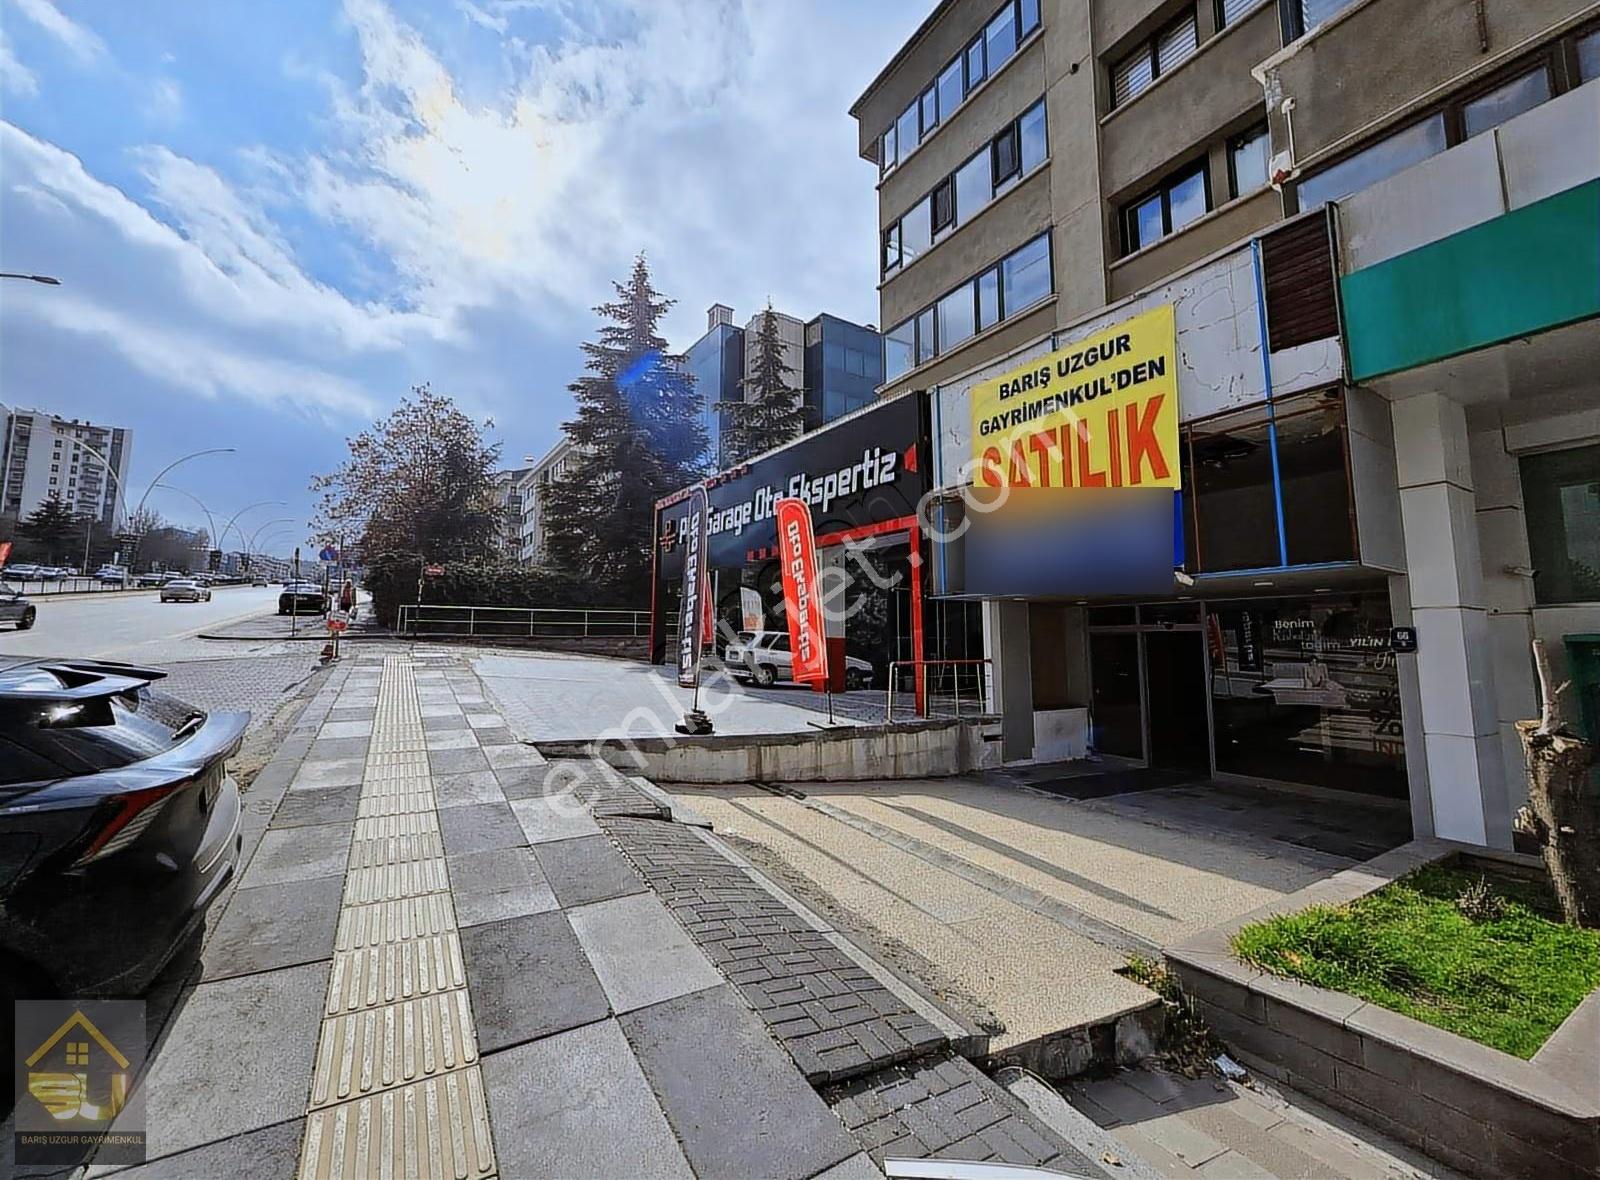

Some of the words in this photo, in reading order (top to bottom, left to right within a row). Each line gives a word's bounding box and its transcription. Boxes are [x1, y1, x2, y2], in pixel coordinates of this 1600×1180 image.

[979, 356, 1166, 437] GAYRİMENKUL'DEN
[999, 366, 1050, 401] BARIŞ
[1057, 334, 1131, 378] UZGUR
[981, 394, 1171, 488] SATILIK
[789, 447, 897, 513] Ekspertiz
